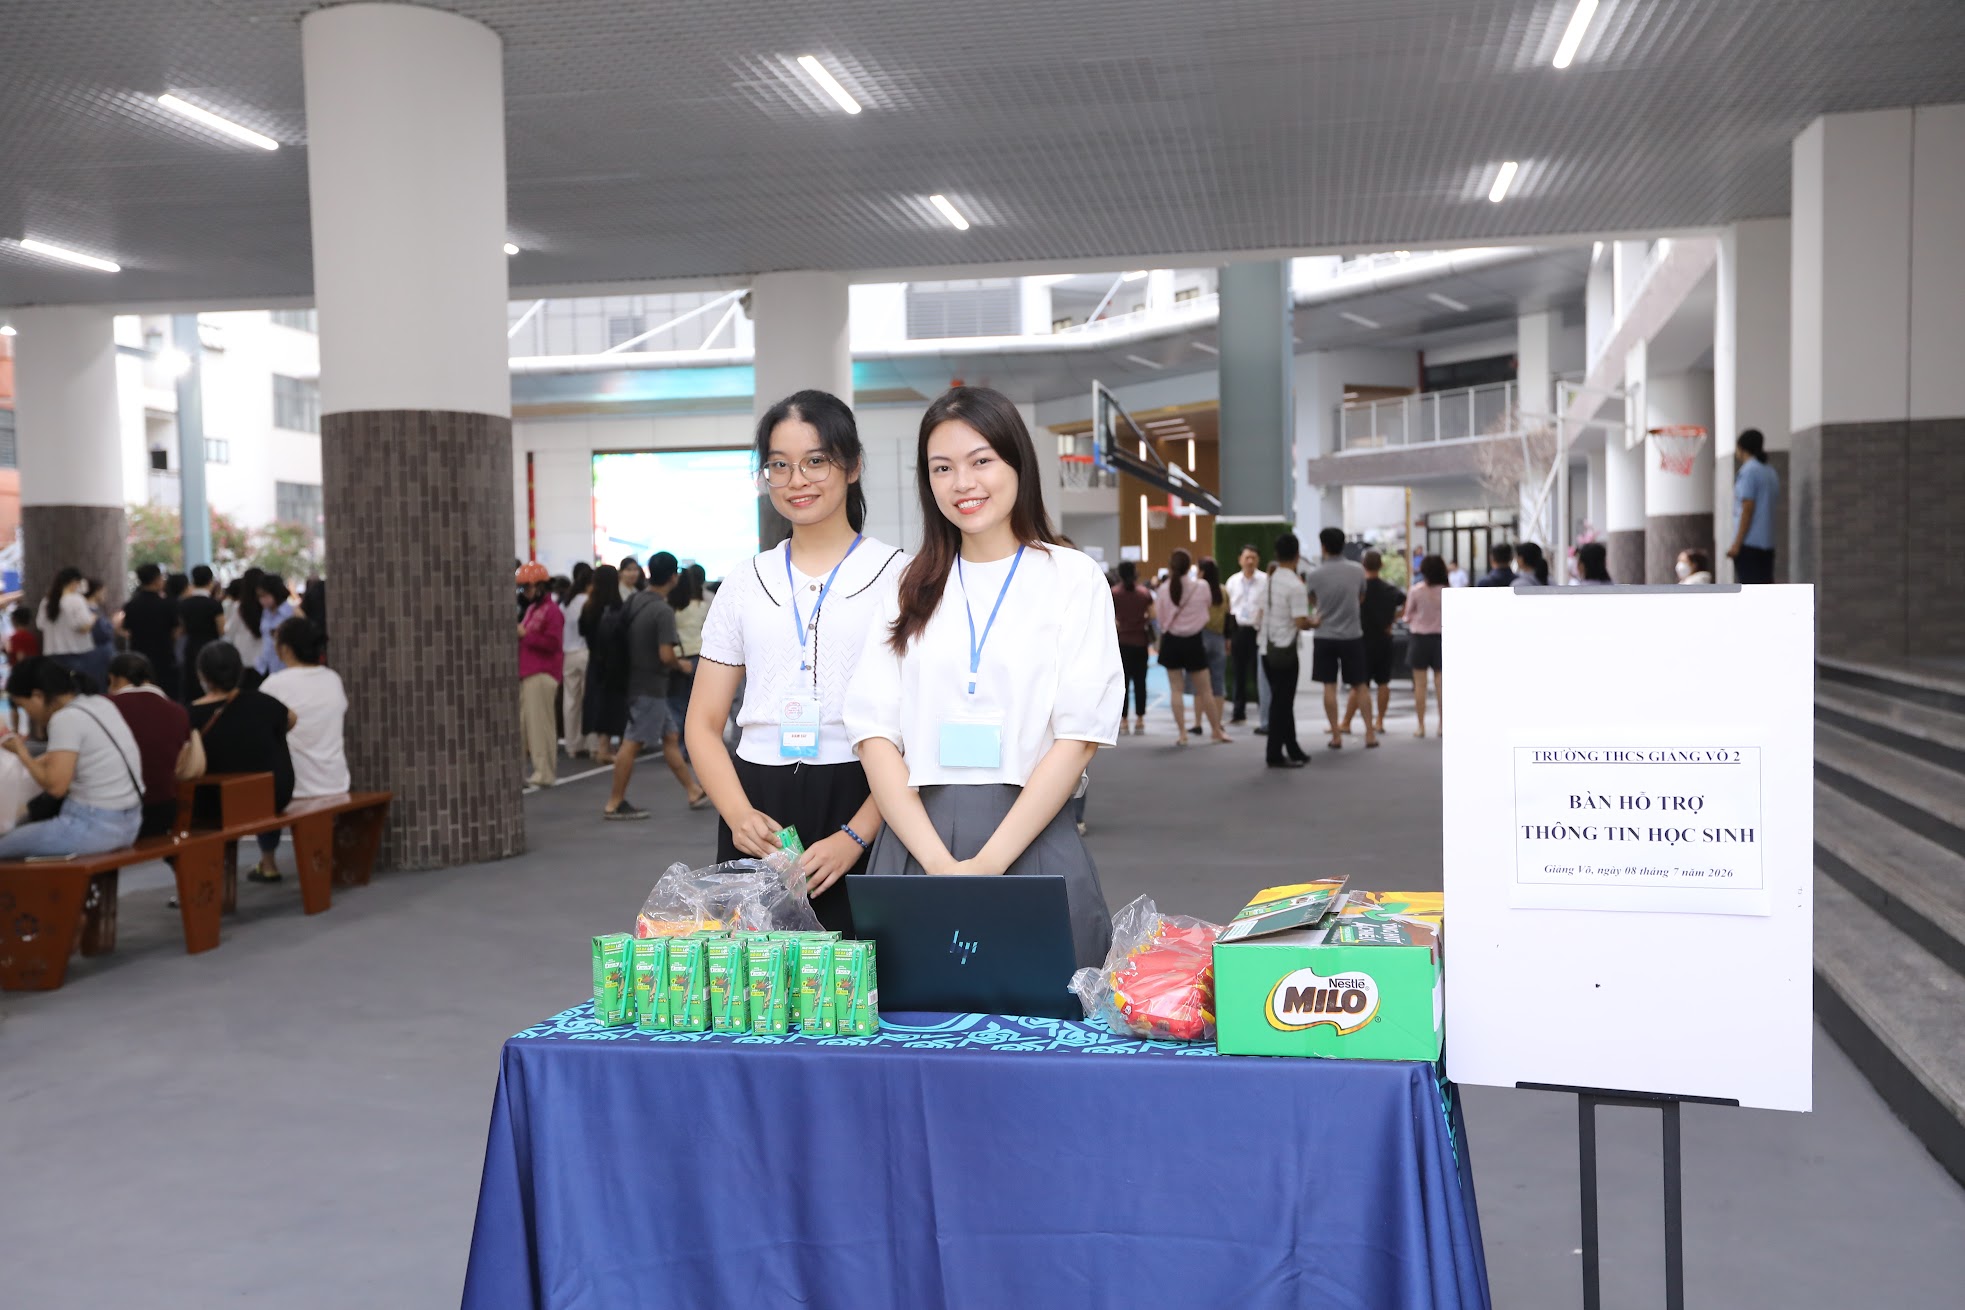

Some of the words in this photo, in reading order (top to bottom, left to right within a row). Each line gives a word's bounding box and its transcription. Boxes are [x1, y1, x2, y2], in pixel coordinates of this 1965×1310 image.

[1532, 747, 1598, 761] TRƯỜNG
[1603, 750, 1644, 761] THCS
[1705, 748, 1729, 761] VÕ
[1733, 750, 1740, 761] 2
[1569, 790, 1612, 809] BÀN
[1619, 791, 1651, 810] HỖ
[1657, 795, 1704, 814] TRỢ
[1521, 821, 1598, 840] THÔNG
[1604, 826, 1640, 841] TIN
[1648, 827, 1696, 846] HỌC
[1703, 827, 1755, 843] SINH
[1578, 865, 1594, 875] Võ,
[1597, 865, 1621, 877] ngày
[1625, 866, 1637, 875] 08
[1640, 866, 1669, 878] tháng
[1674, 867, 1679, 876] 7
[1681, 868, 1705, 877] năm
[1708, 868, 1734, 878] 2026
[1328, 978, 1365, 988] Nestlé
[1282, 986, 1367, 1014] MILO
